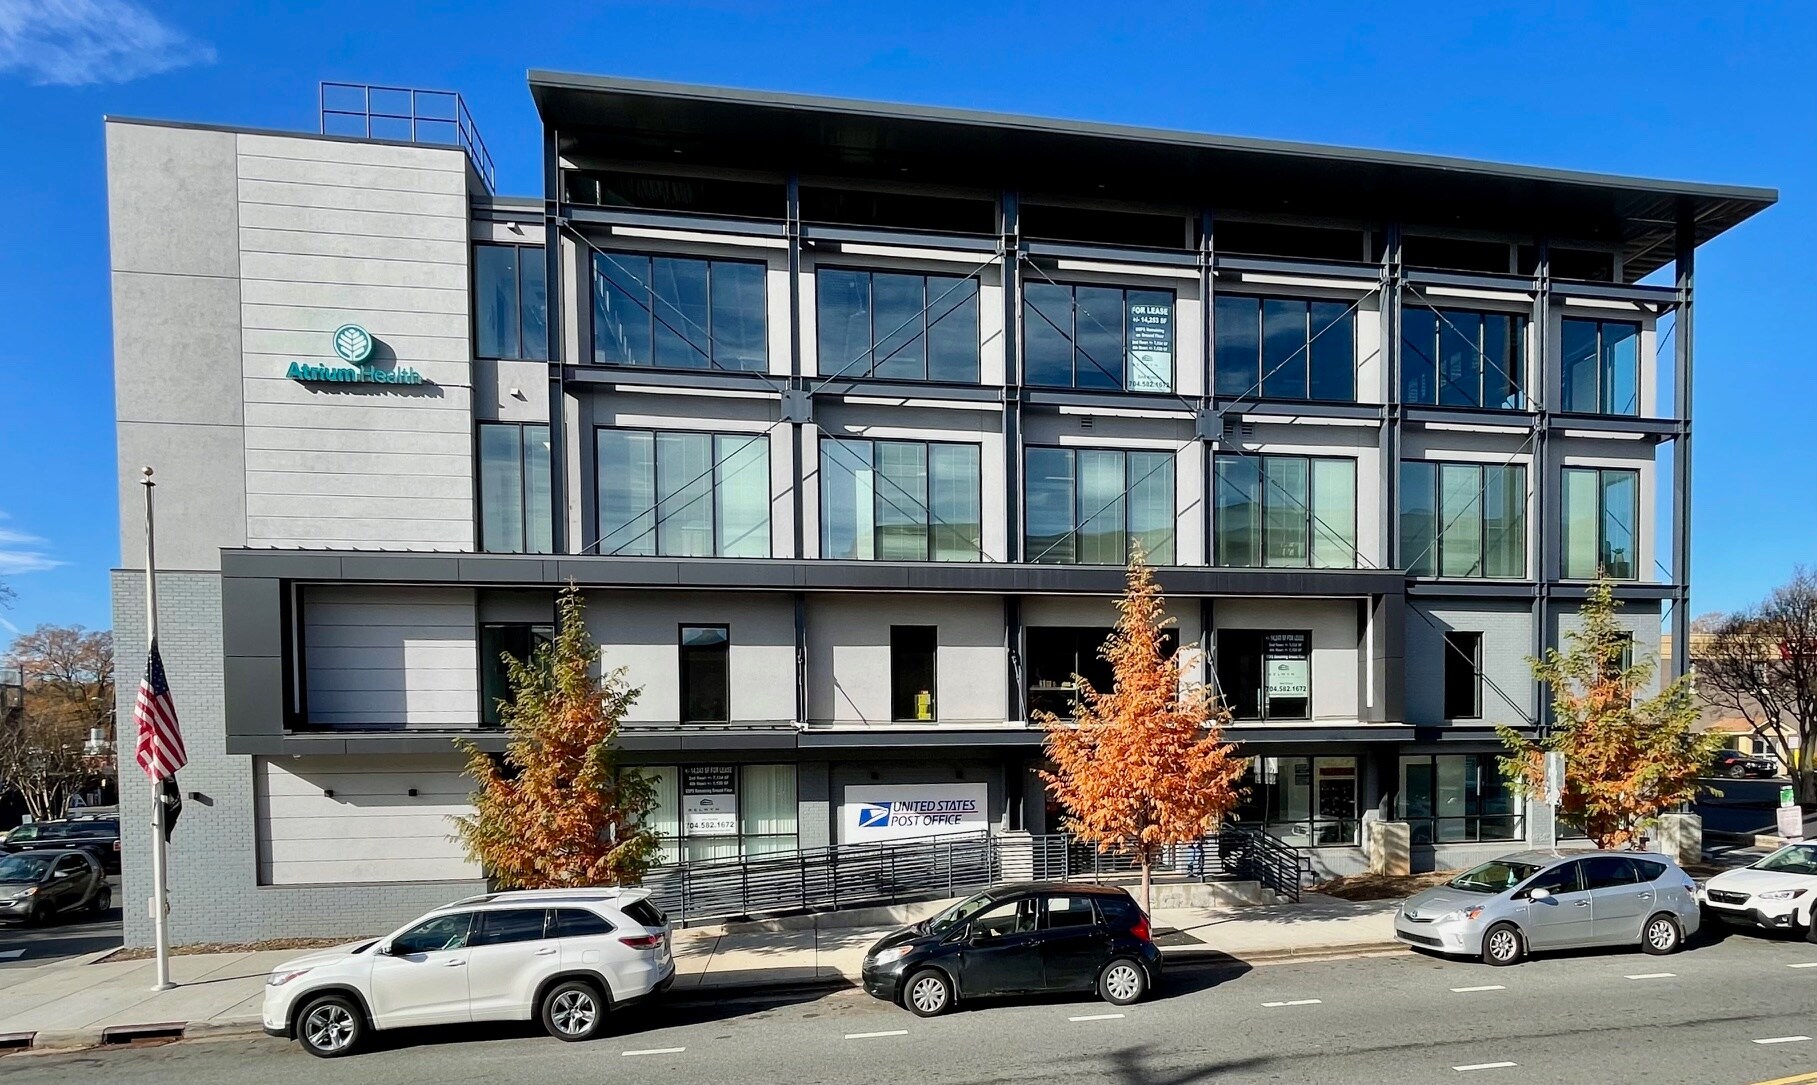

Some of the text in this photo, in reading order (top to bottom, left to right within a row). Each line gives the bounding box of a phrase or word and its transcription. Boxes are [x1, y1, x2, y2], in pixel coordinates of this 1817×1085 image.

[1131, 305, 1169, 316] FOR LEASE
[286, 361, 424, 385] Atrium Health
[893, 799, 976, 813] UNITED STATES
[890, 814, 962, 827] POST OFFICE
